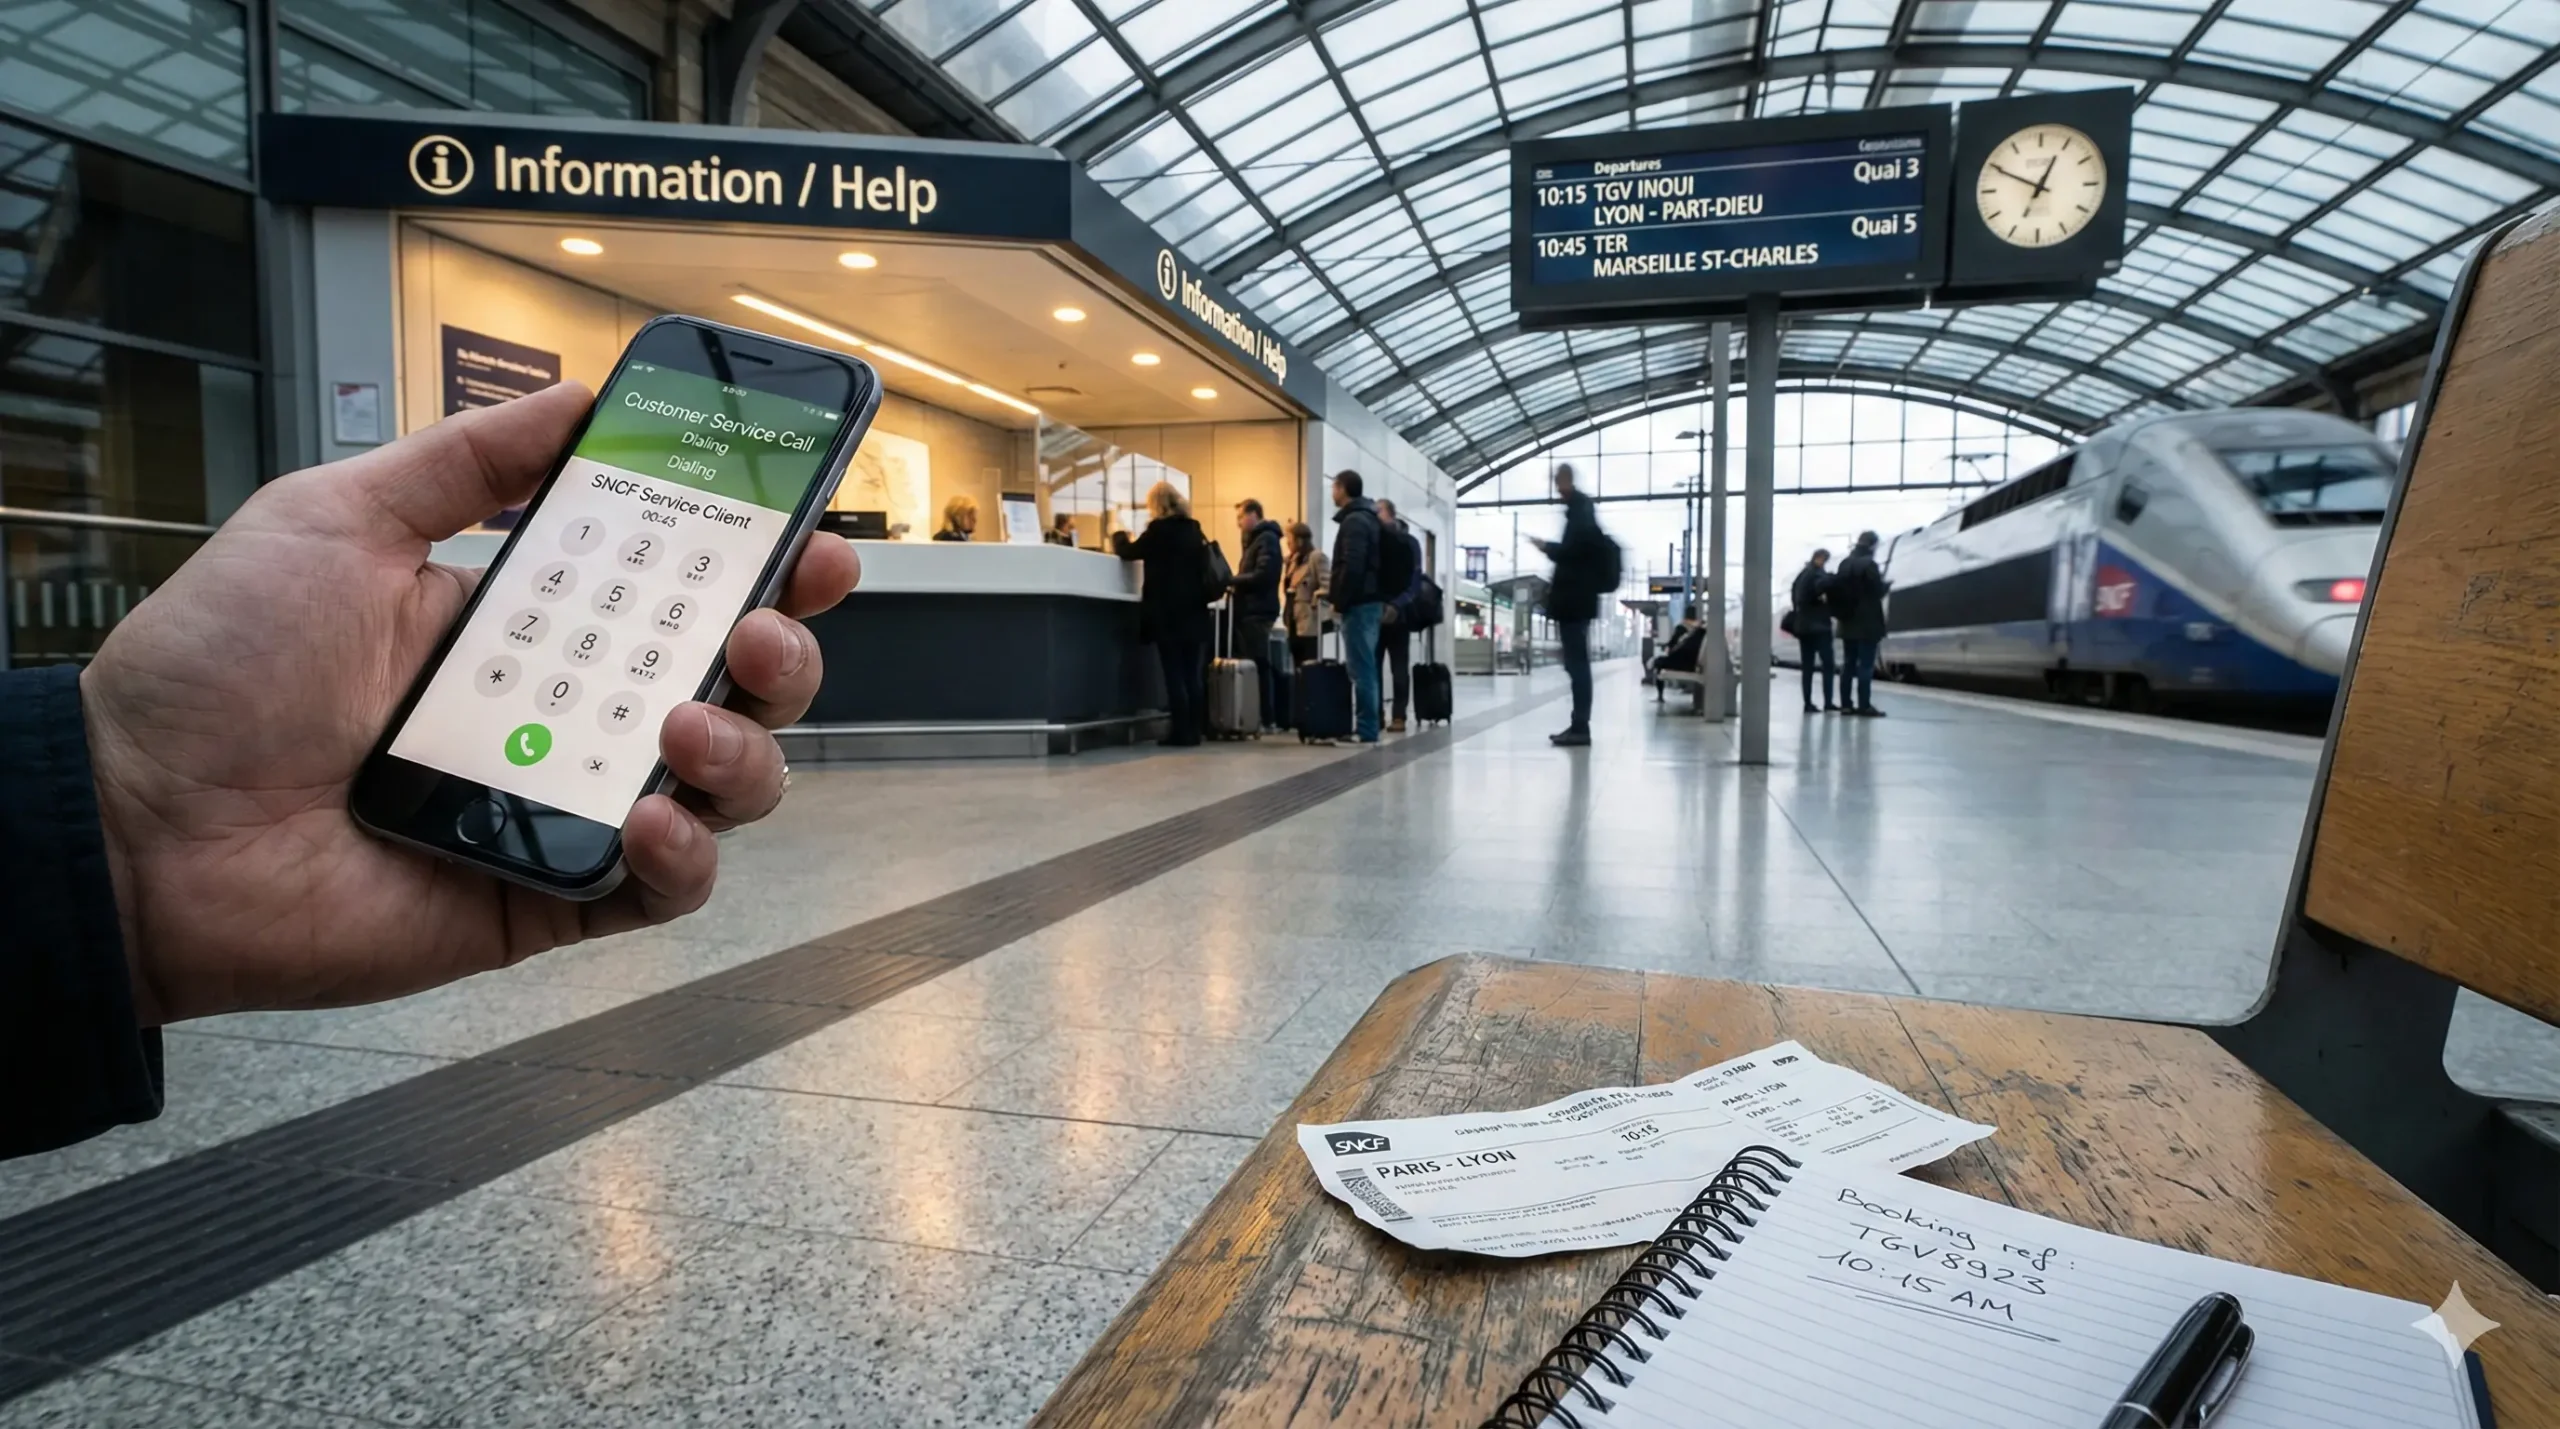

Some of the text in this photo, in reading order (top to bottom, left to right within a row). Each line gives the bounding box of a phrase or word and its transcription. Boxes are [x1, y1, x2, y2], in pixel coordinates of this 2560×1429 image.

[1594, 159, 1662, 177] Departures
[1854, 157, 1920, 184] Quai 3
[495, 145, 938, 225] Information / Help
[1538, 175, 1694, 206] 10:15 TGV INOUI
[1594, 204, 1644, 226] LYON
[1662, 194, 1763, 221] PART-DIEU
[1851, 212, 1917, 239] Quai 5
[1538, 234, 1628, 257] 10:45 TER
[1594, 243, 1819, 277] MARSEILLE ST-CHARLES
[1182, 270, 1255, 356] Information
[1263, 335, 1287, 386] Help
[624, 391, 816, 453] Customer Service Call
[591, 474, 752, 530] SNCF Service Client
[641, 509, 678, 528] 00:45
[578, 525, 591, 540] 1
[634, 540, 651, 557] 2
[694, 556, 711, 573] 3
[548, 570, 565, 586] 4
[608, 585, 626, 602] 5
[669, 602, 686, 620] 6
[521, 614, 538, 631] 7
[580, 632, 597, 650] 8
[642, 650, 659, 668] 9
[552, 681, 569, 699] 0
[1620, 1124, 1659, 1142] 10:15
[1335, 1137, 1385, 1154] SNCF
[1376, 1161, 1441, 1179] PARIS
[1456, 1149, 1517, 1168] LYON
[1837, 1188, 1975, 1250] Booking
[1850, 1221, 2047, 1296] TGV8923
[1817, 1250, 2014, 1322] 10:15 AM
